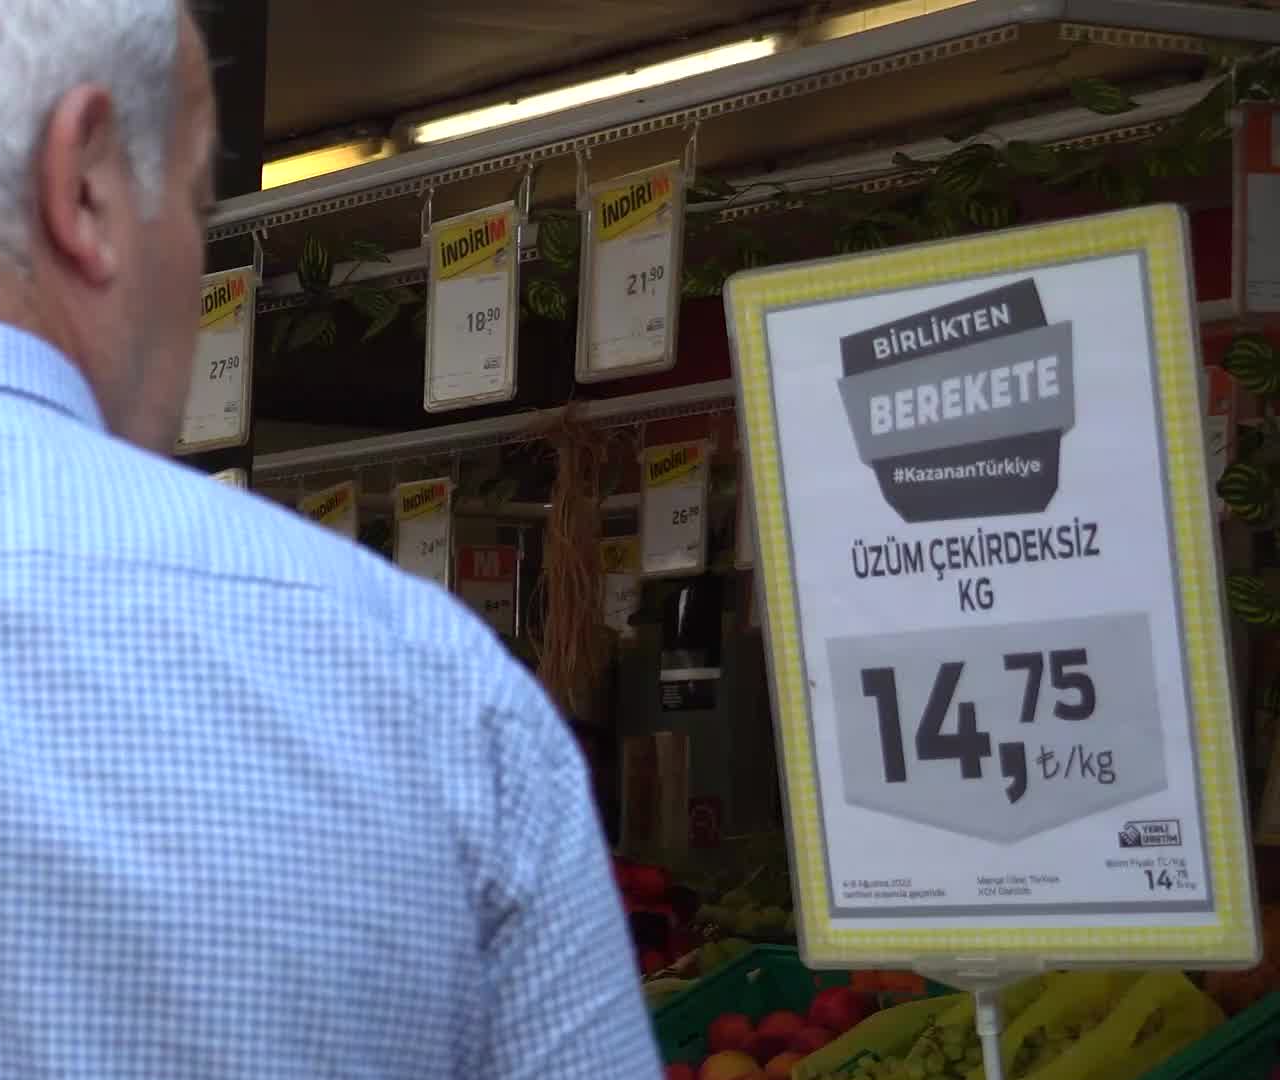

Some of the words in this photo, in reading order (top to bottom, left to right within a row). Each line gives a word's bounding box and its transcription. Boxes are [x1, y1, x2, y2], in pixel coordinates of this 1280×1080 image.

[872, 303, 1011, 360] BİRLİKTEN
[869, 355, 1061, 436] BEREKETE
[892, 456, 1042, 485] #KazananTürkiye
[851, 538, 925, 580] ÜZÜM
[928, 517, 1101, 582] ÇEKİRDEKSİZ
[957, 576, 995, 611] KG
